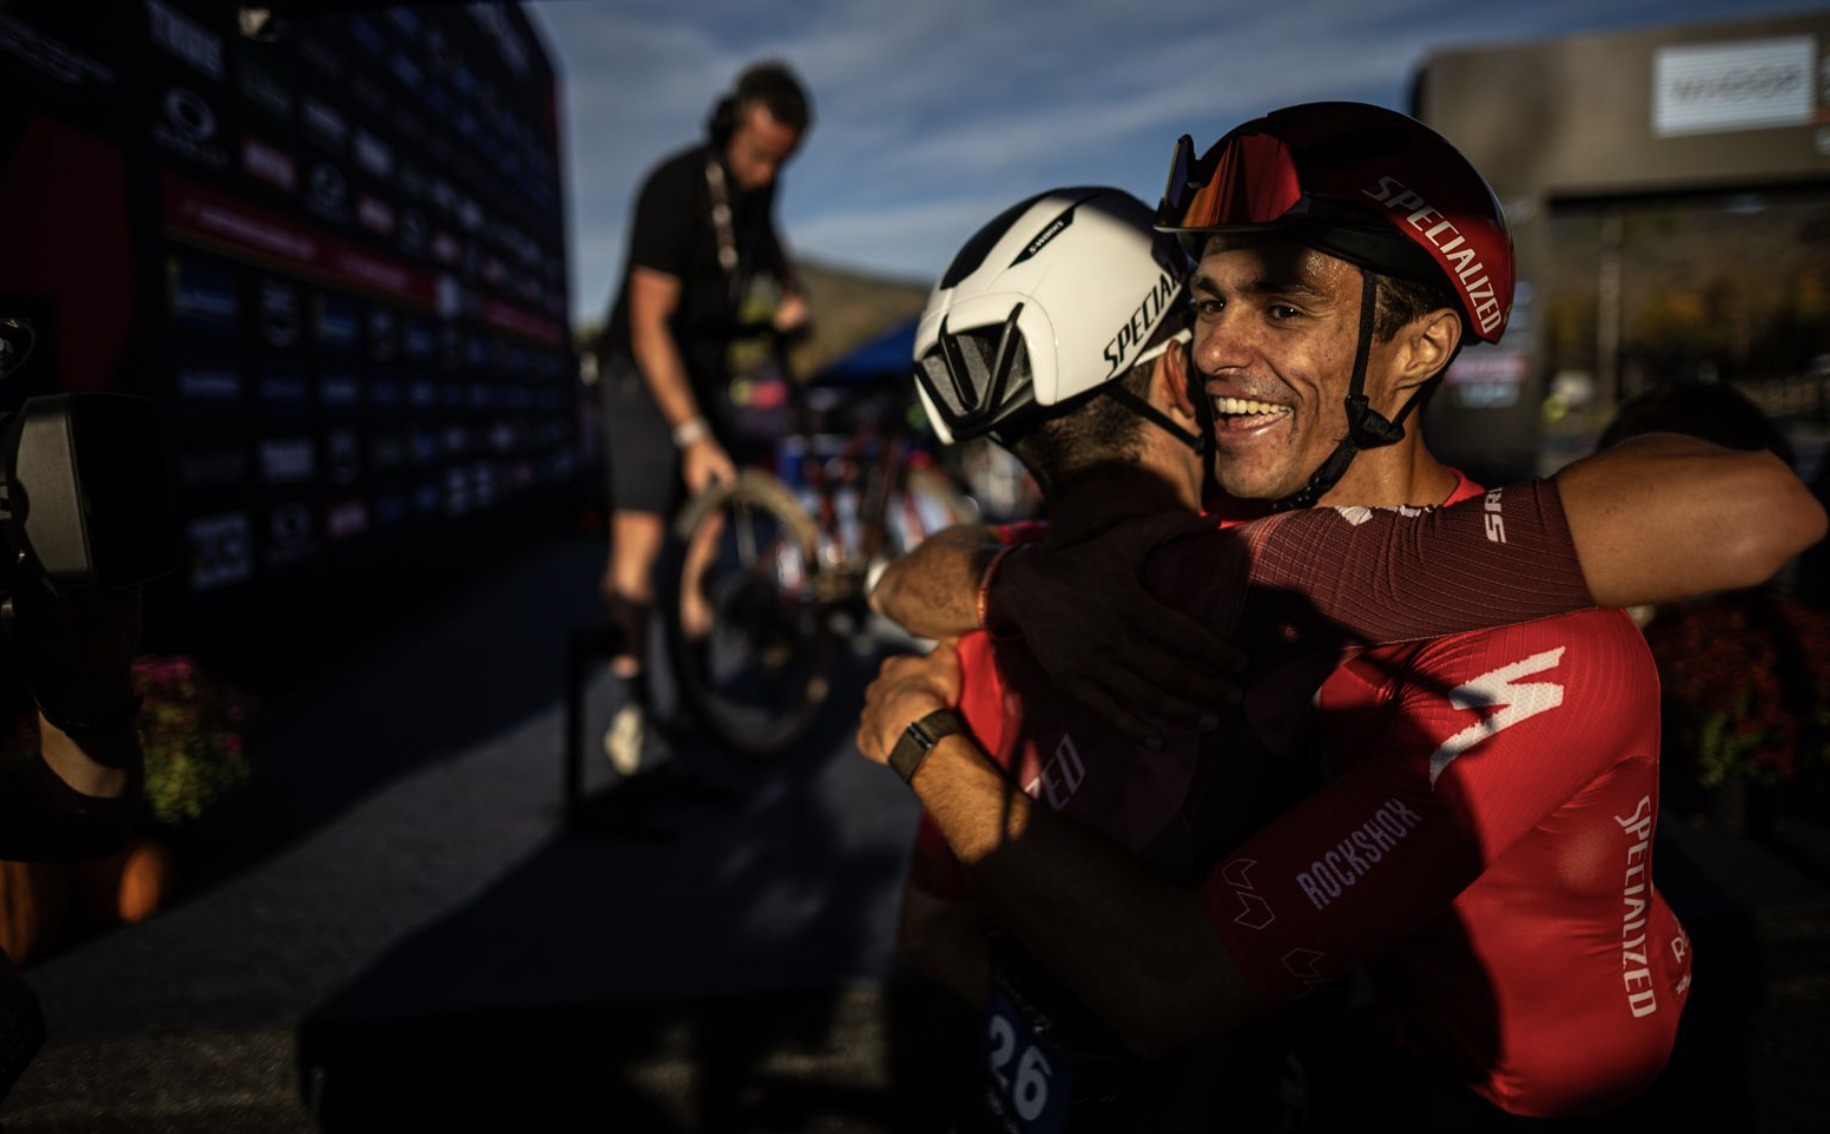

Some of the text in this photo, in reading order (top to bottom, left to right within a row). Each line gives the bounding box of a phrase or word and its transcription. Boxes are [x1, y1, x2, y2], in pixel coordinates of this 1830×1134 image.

[1361, 175, 1502, 334] SPECIALIZED
[1296, 797, 1423, 911] ROCKSHOX
[1614, 795, 1656, 1018] SPECIALIZED
[987, 1014, 1054, 1122] 26
